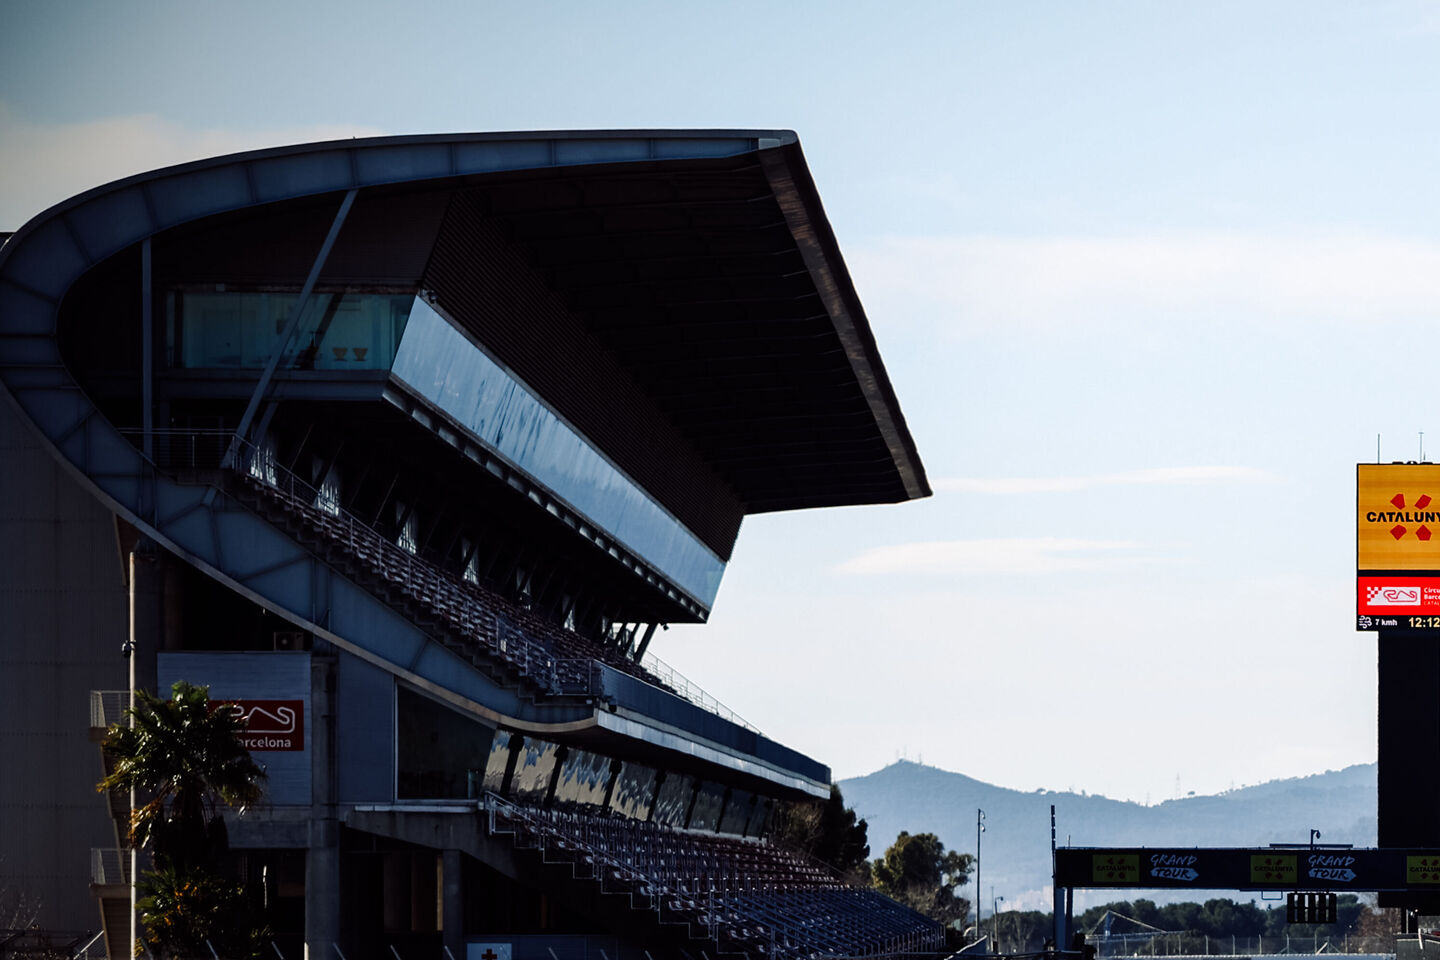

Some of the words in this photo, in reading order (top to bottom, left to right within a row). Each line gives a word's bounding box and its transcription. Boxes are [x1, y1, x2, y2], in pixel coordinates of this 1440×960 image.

[1381, 618, 1398, 626] kmh
[236, 736, 292, 748] arcelona
[1150, 853, 1198, 866] GRAND
[1307, 854, 1356, 867] GRAND
[1155, 867, 1190, 879] TOUR
[1313, 868, 1349, 879] TOUR
